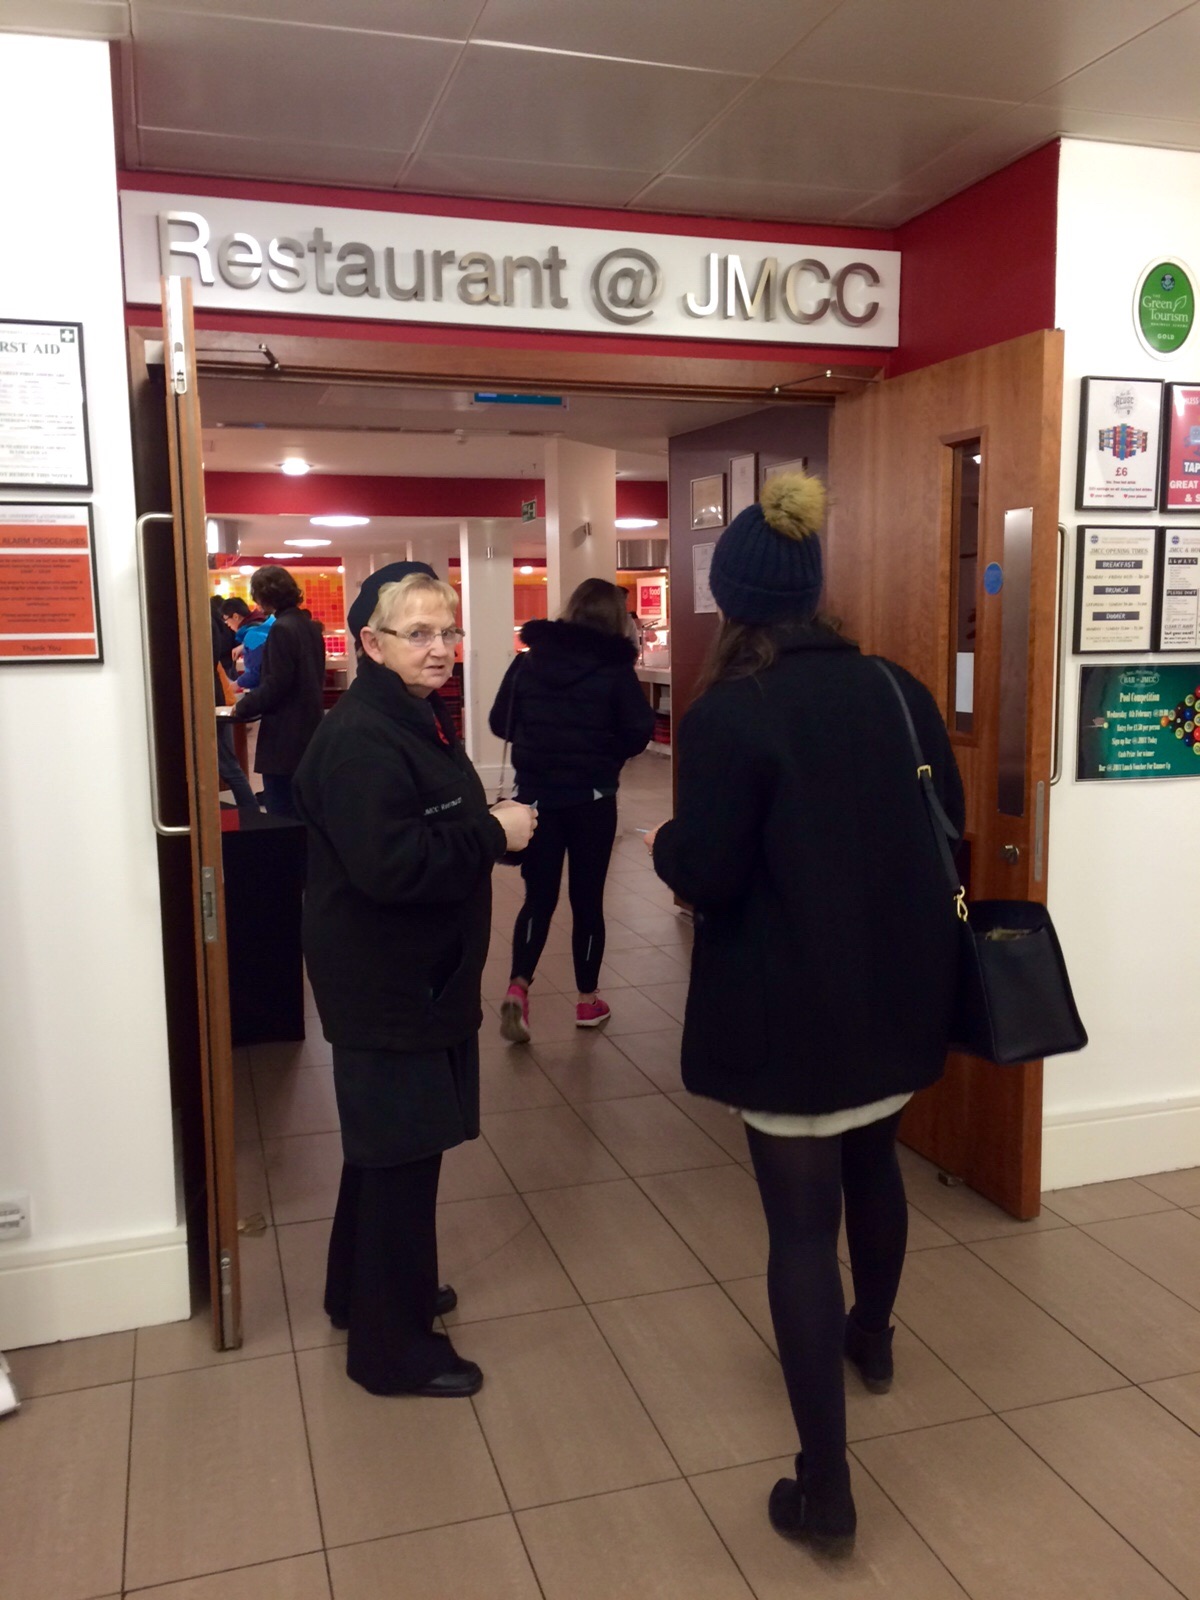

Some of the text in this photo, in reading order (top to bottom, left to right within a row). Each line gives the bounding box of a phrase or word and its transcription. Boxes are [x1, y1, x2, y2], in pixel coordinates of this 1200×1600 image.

[157, 209, 880, 328] Restaurant @ JMCC
[1142, 295, 1173, 310] Green
[1149, 308, 1189, 322] Tourism
[33, 343, 61, 355] AID
[1115, 467, 1128, 477] £6
[1169, 480, 1199, 489] GREAT
[1184, 494, 1193, 502] &
[1120, 692, 1160, 704] Pool Competition
